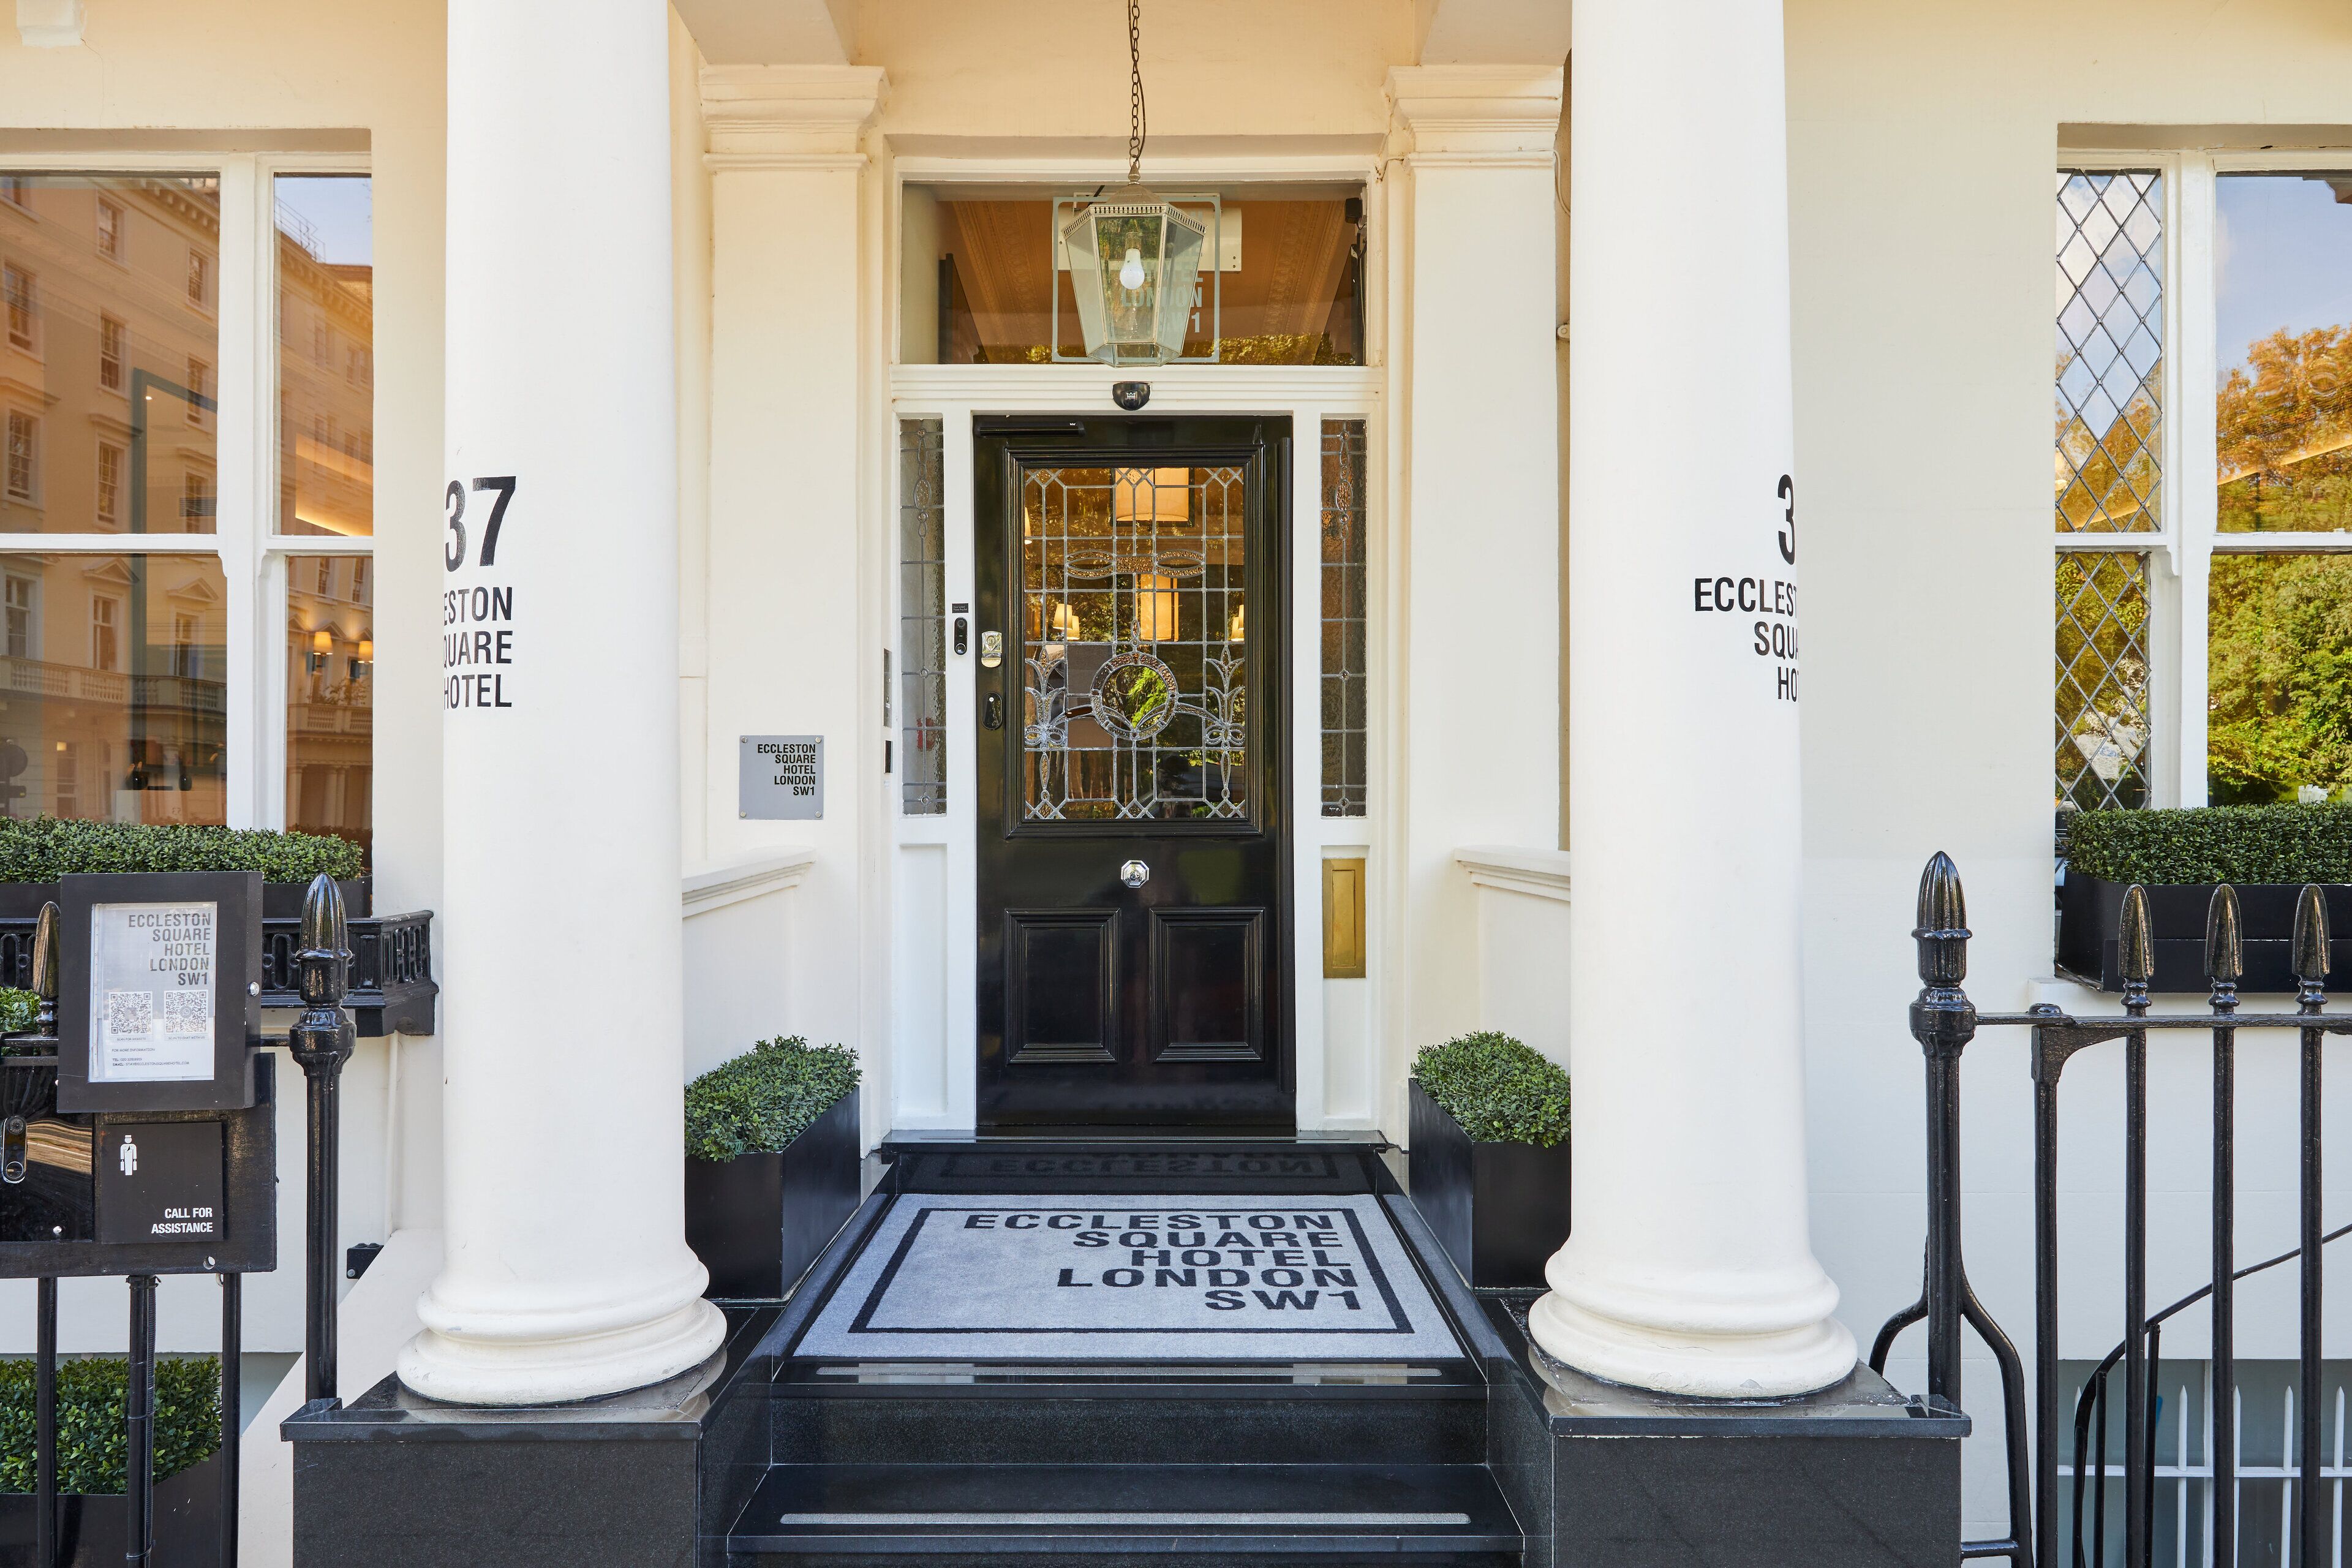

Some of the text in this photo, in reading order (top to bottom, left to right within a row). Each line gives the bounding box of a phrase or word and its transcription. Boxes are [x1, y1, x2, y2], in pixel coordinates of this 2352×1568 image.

[445, 476, 516, 572] 37
[1777, 474, 1795, 565] 3
[444, 586, 513, 626] ESTON
[444, 630, 513, 669] QUARE
[444, 674, 512, 710] HOTEL
[757, 744, 816, 754] ECCLESTON
[775, 754, 816, 764] SQUARE
[783, 765, 816, 774] HOTEL
[774, 775, 815, 785] LONDON
[793, 786, 815, 796] SW1
[129, 913, 211, 927] ECCLESTON
[153, 928, 211, 942] SQUARE
[164, 943, 209, 956] HOTEL
[149, 957, 209, 971] LONDON
[178, 972, 208, 986] SW1
[165, 1207, 213, 1219] CALL FOR
[151, 1222, 213, 1234] ASSISTANCE
[963, 1214, 1334, 1229] ECCLESTON
[1073, 1231, 1343, 1248] SQUARE
[1132, 1250, 1351, 1267] HOTEL
[1057, 1268, 1359, 1287] LONDON
[1205, 1290, 1361, 1310] SW1
